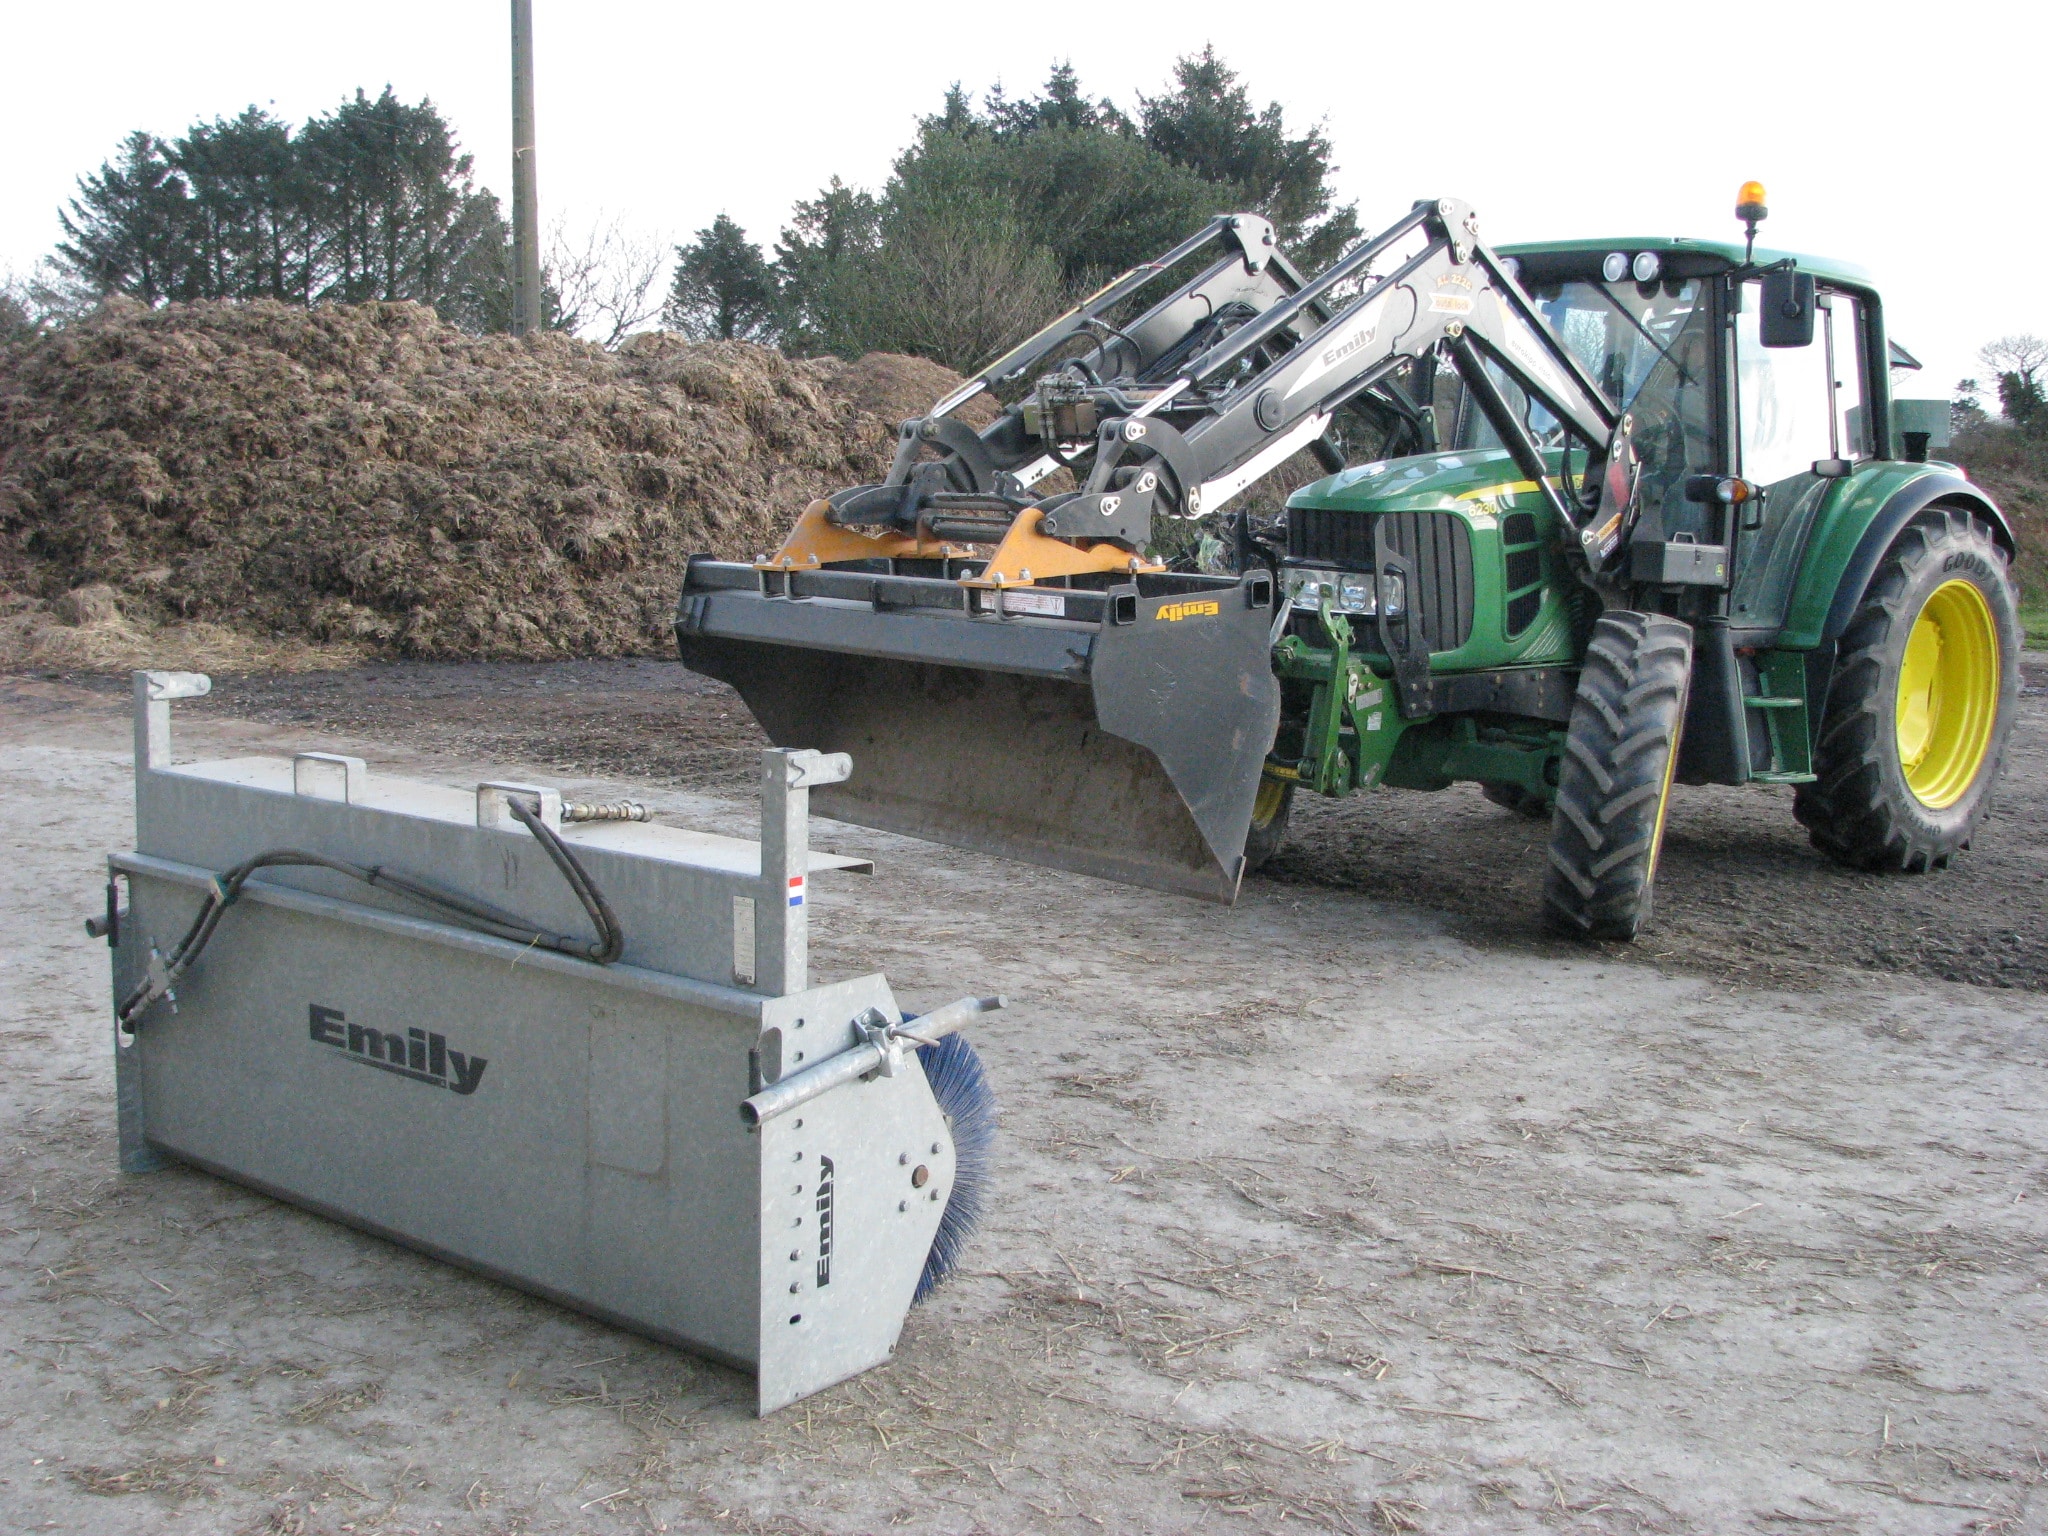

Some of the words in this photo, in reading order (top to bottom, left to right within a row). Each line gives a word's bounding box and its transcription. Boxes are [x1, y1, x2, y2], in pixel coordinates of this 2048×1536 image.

[1322, 326, 1376, 367] Emily
[1468, 502, 1497, 516] 6230
[1155, 600, 1219, 622] Emily
[309, 1003, 488, 1095] Emily
[816, 1154, 834, 1288] Emily
